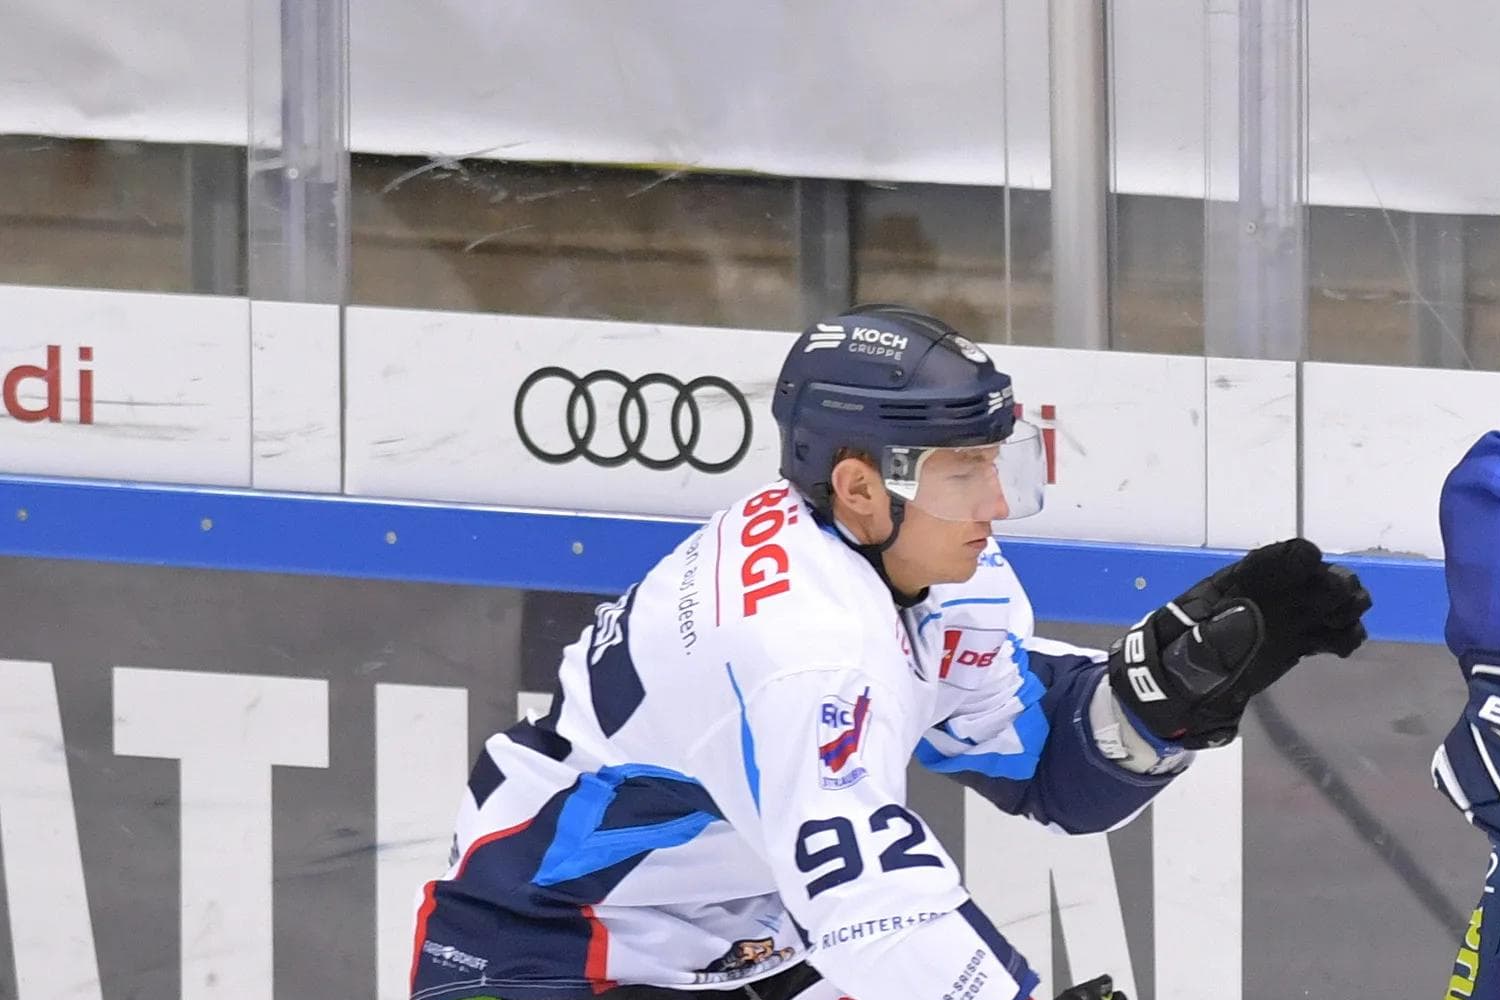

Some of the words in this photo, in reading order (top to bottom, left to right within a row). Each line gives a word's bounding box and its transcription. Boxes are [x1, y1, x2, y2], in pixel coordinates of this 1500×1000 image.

[848, 342, 904, 361] GRUPPE
[851, 327, 908, 350] KOCH
[741, 486, 798, 618] BÖGL
[795, 804, 946, 901] 92
